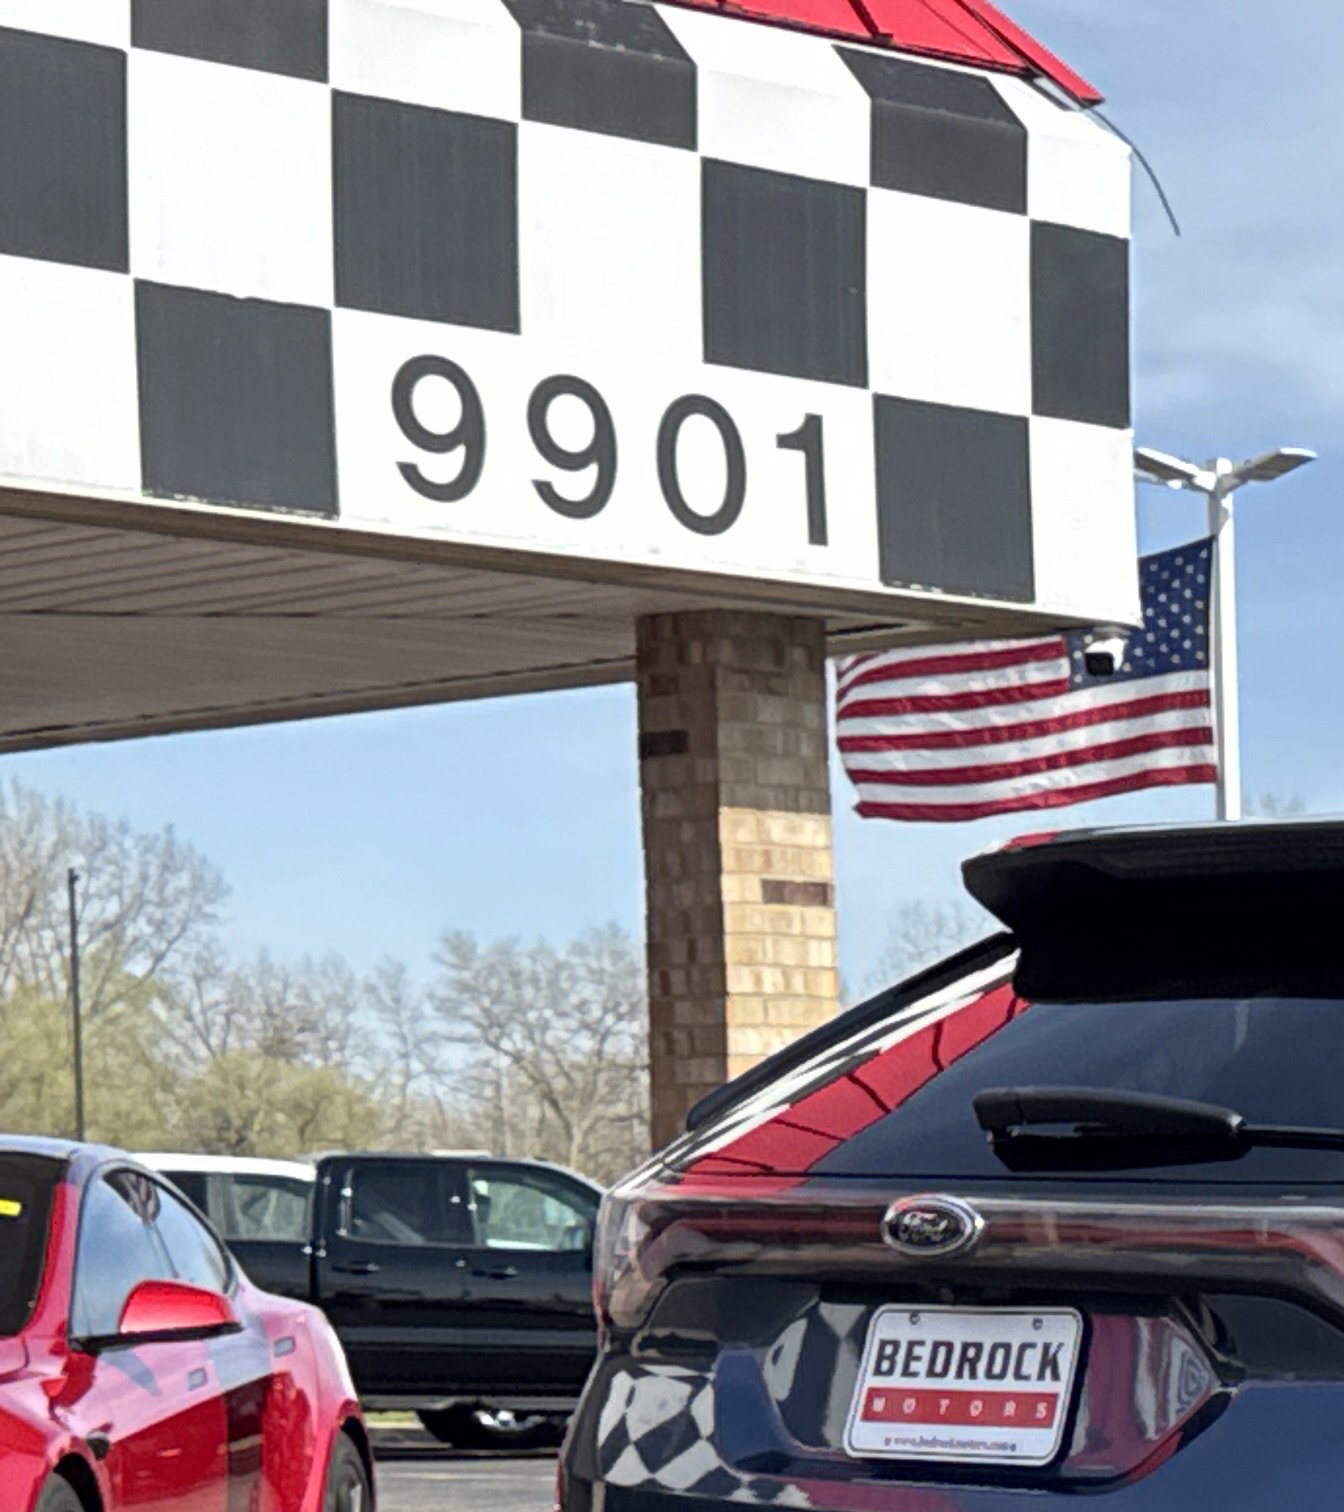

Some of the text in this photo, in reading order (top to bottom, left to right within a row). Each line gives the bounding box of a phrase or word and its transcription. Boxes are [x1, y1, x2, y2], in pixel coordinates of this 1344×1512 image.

[391, 354, 829, 547] 9901
[872, 1338, 1065, 1382] BEDROCK
[872, 1396, 1048, 1420] MOTORS
